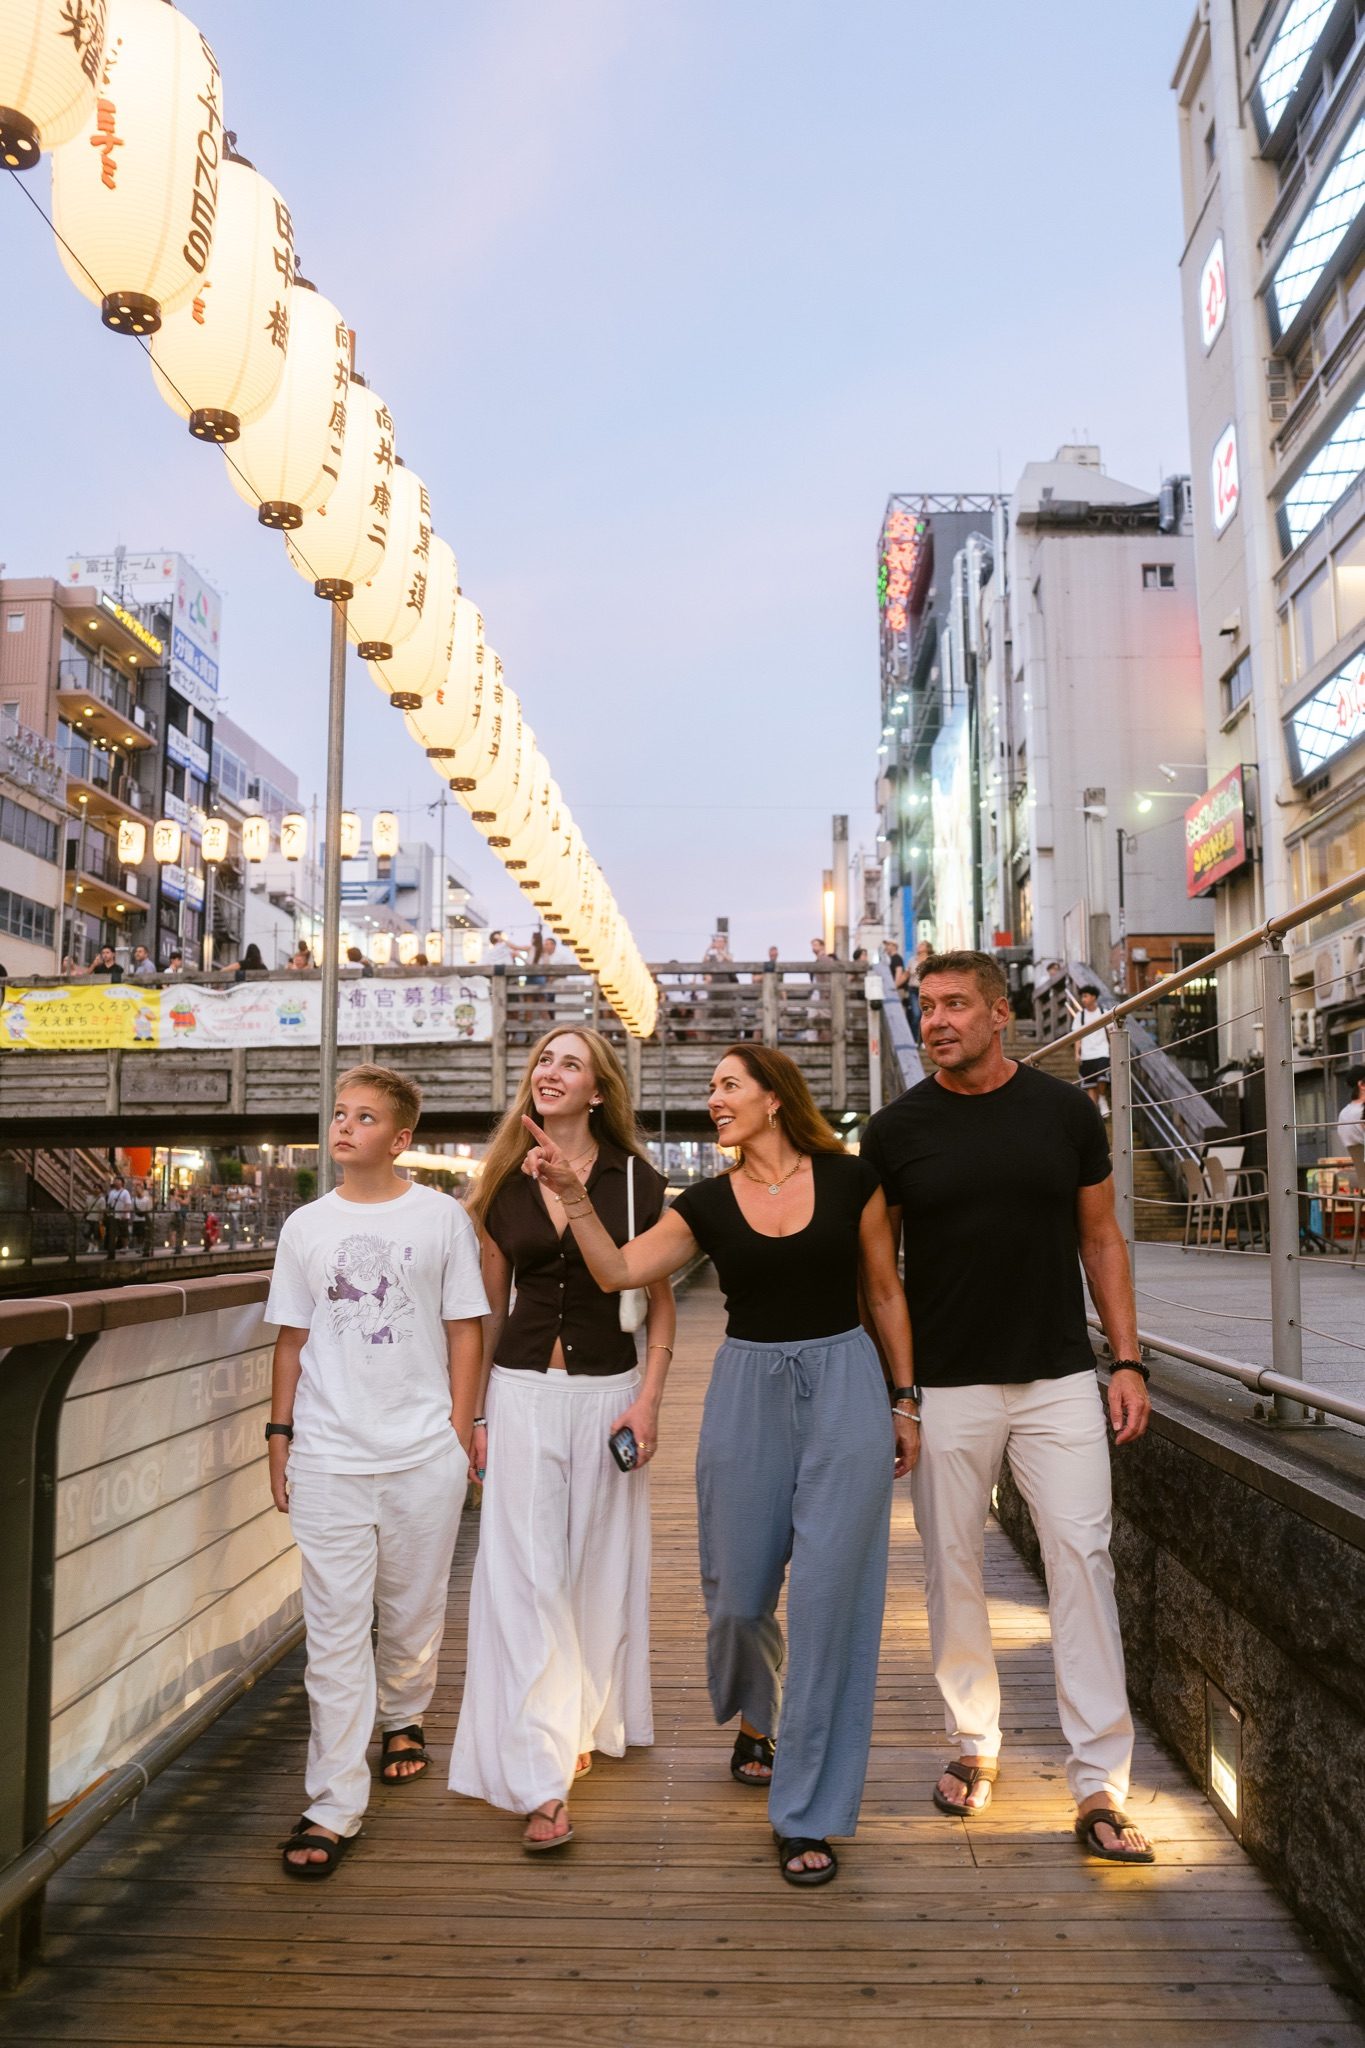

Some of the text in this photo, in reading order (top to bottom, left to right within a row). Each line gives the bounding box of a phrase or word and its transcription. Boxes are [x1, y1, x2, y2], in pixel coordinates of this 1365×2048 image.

[367, 404, 395, 551] 向井康二
[338, 986, 477, 1009] 衛官募集中
[33, 1001, 131, 1013] みんなでつくろう
[40, 1015, 124, 1026] ええまちミナミ
